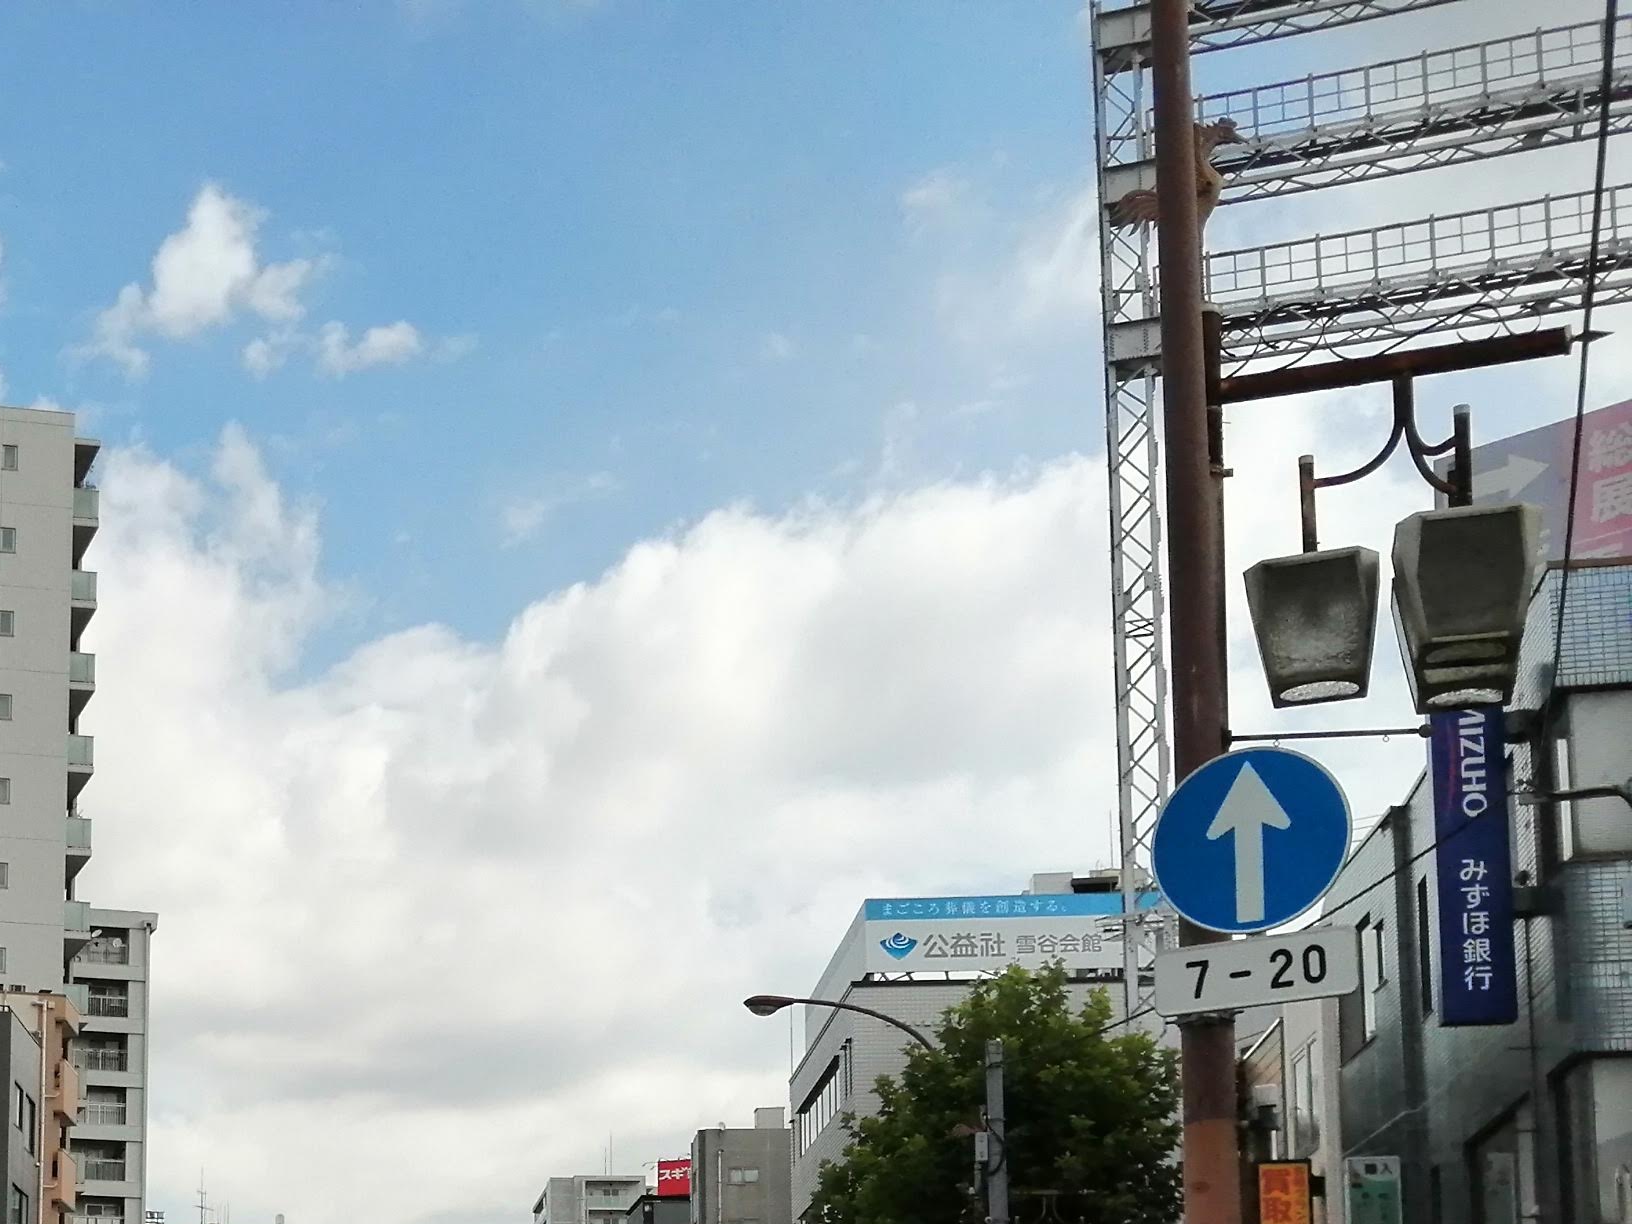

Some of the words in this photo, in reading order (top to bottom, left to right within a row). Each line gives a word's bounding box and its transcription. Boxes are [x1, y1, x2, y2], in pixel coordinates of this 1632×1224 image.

[1459, 858, 1493, 990] みずほ銀行
[923, 932, 1006, 958] 公益社
[1016, 933, 1102, 954] 雪谷会館
[1186, 944, 1327, 999] 7-20
[659, 1167, 692, 1180] スギ
